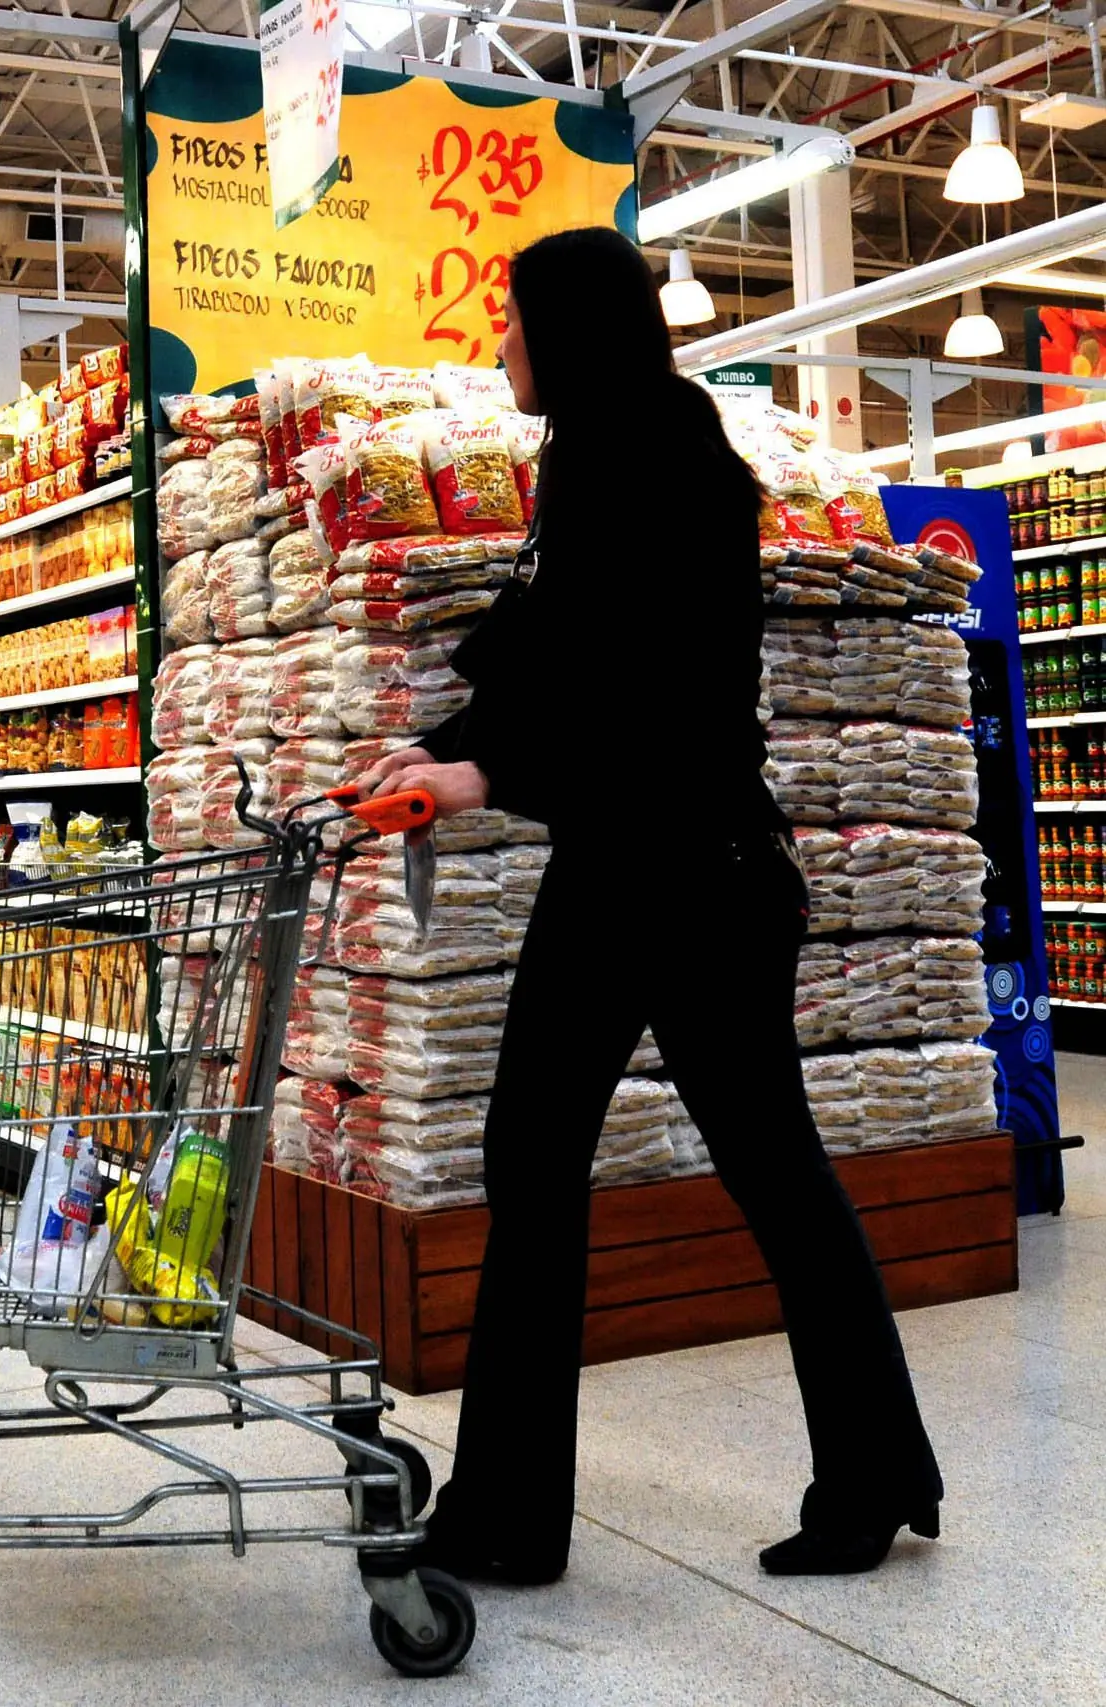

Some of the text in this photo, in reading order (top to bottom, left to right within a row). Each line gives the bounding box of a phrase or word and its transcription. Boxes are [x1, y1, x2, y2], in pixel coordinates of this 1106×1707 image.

[170, 132, 246, 170] FIDEOS
[174, 239, 376, 296] FIDEOS FAVORITA
[715, 372, 756, 384] JUMBO
